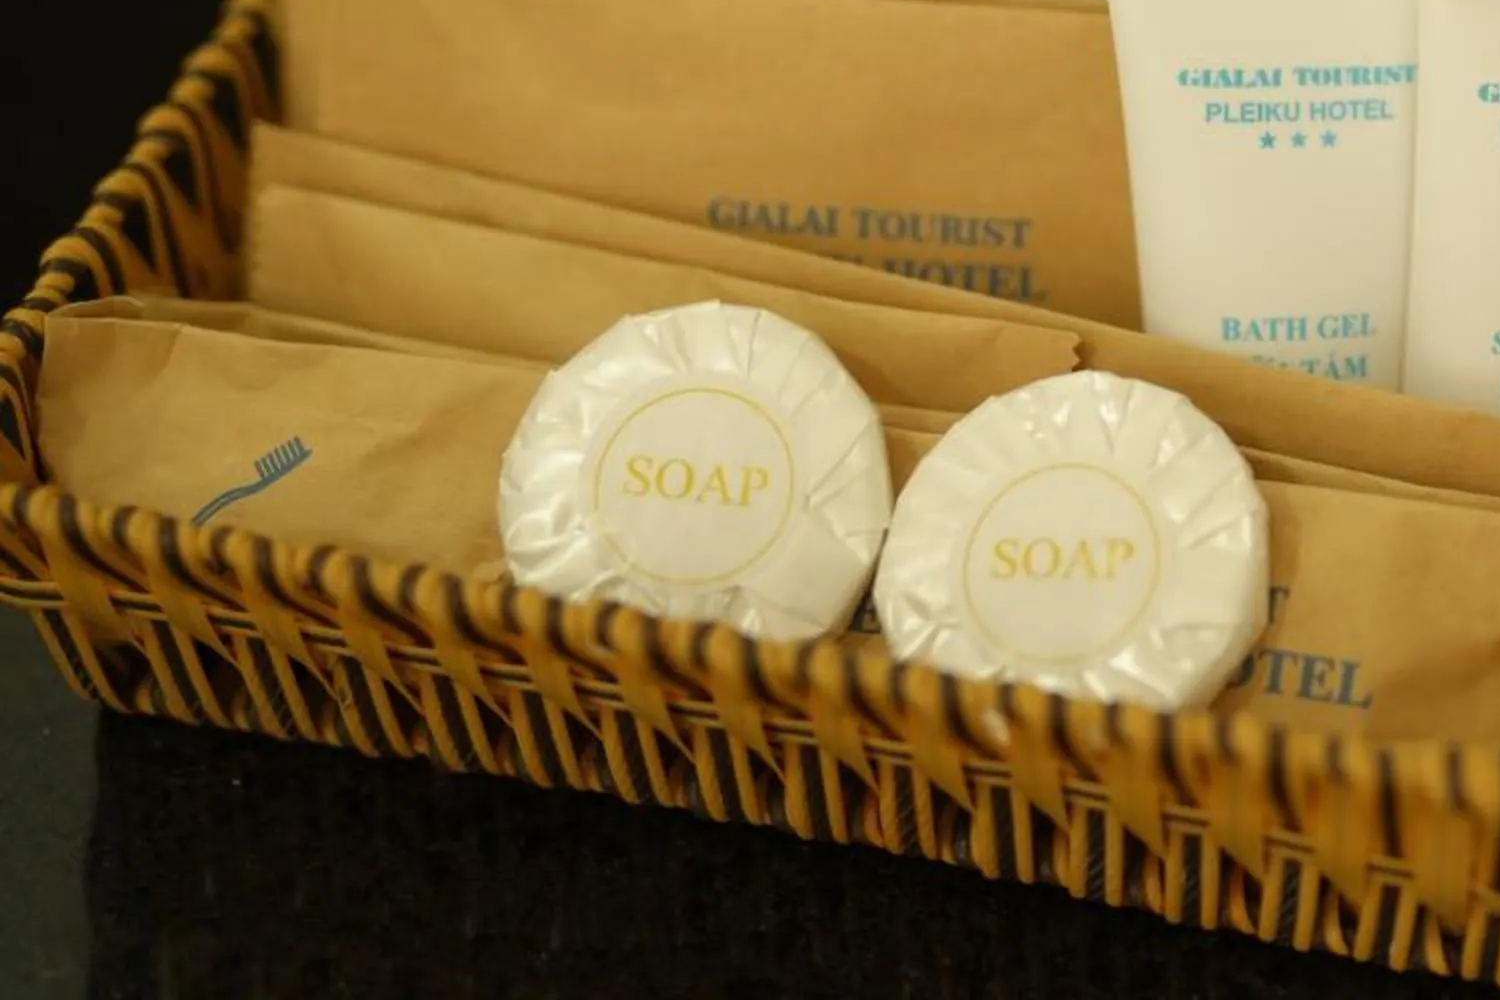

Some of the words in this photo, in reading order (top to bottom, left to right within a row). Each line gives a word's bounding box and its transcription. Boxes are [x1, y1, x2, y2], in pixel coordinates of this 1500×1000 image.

[1176, 67, 1282, 88] GIALAI
[1293, 63, 1417, 87] TOURIST
[1205, 101, 1301, 124] PLEIKU
[1309, 99, 1395, 121] HOTEL
[707, 194, 840, 238] GIALAI
[853, 206, 1033, 249] TOURIST
[1221, 315, 1308, 342] BATH
[1316, 312, 1377, 340] GEL
[623, 455, 770, 508] SOAP
[990, 536, 1135, 582] SOAP
